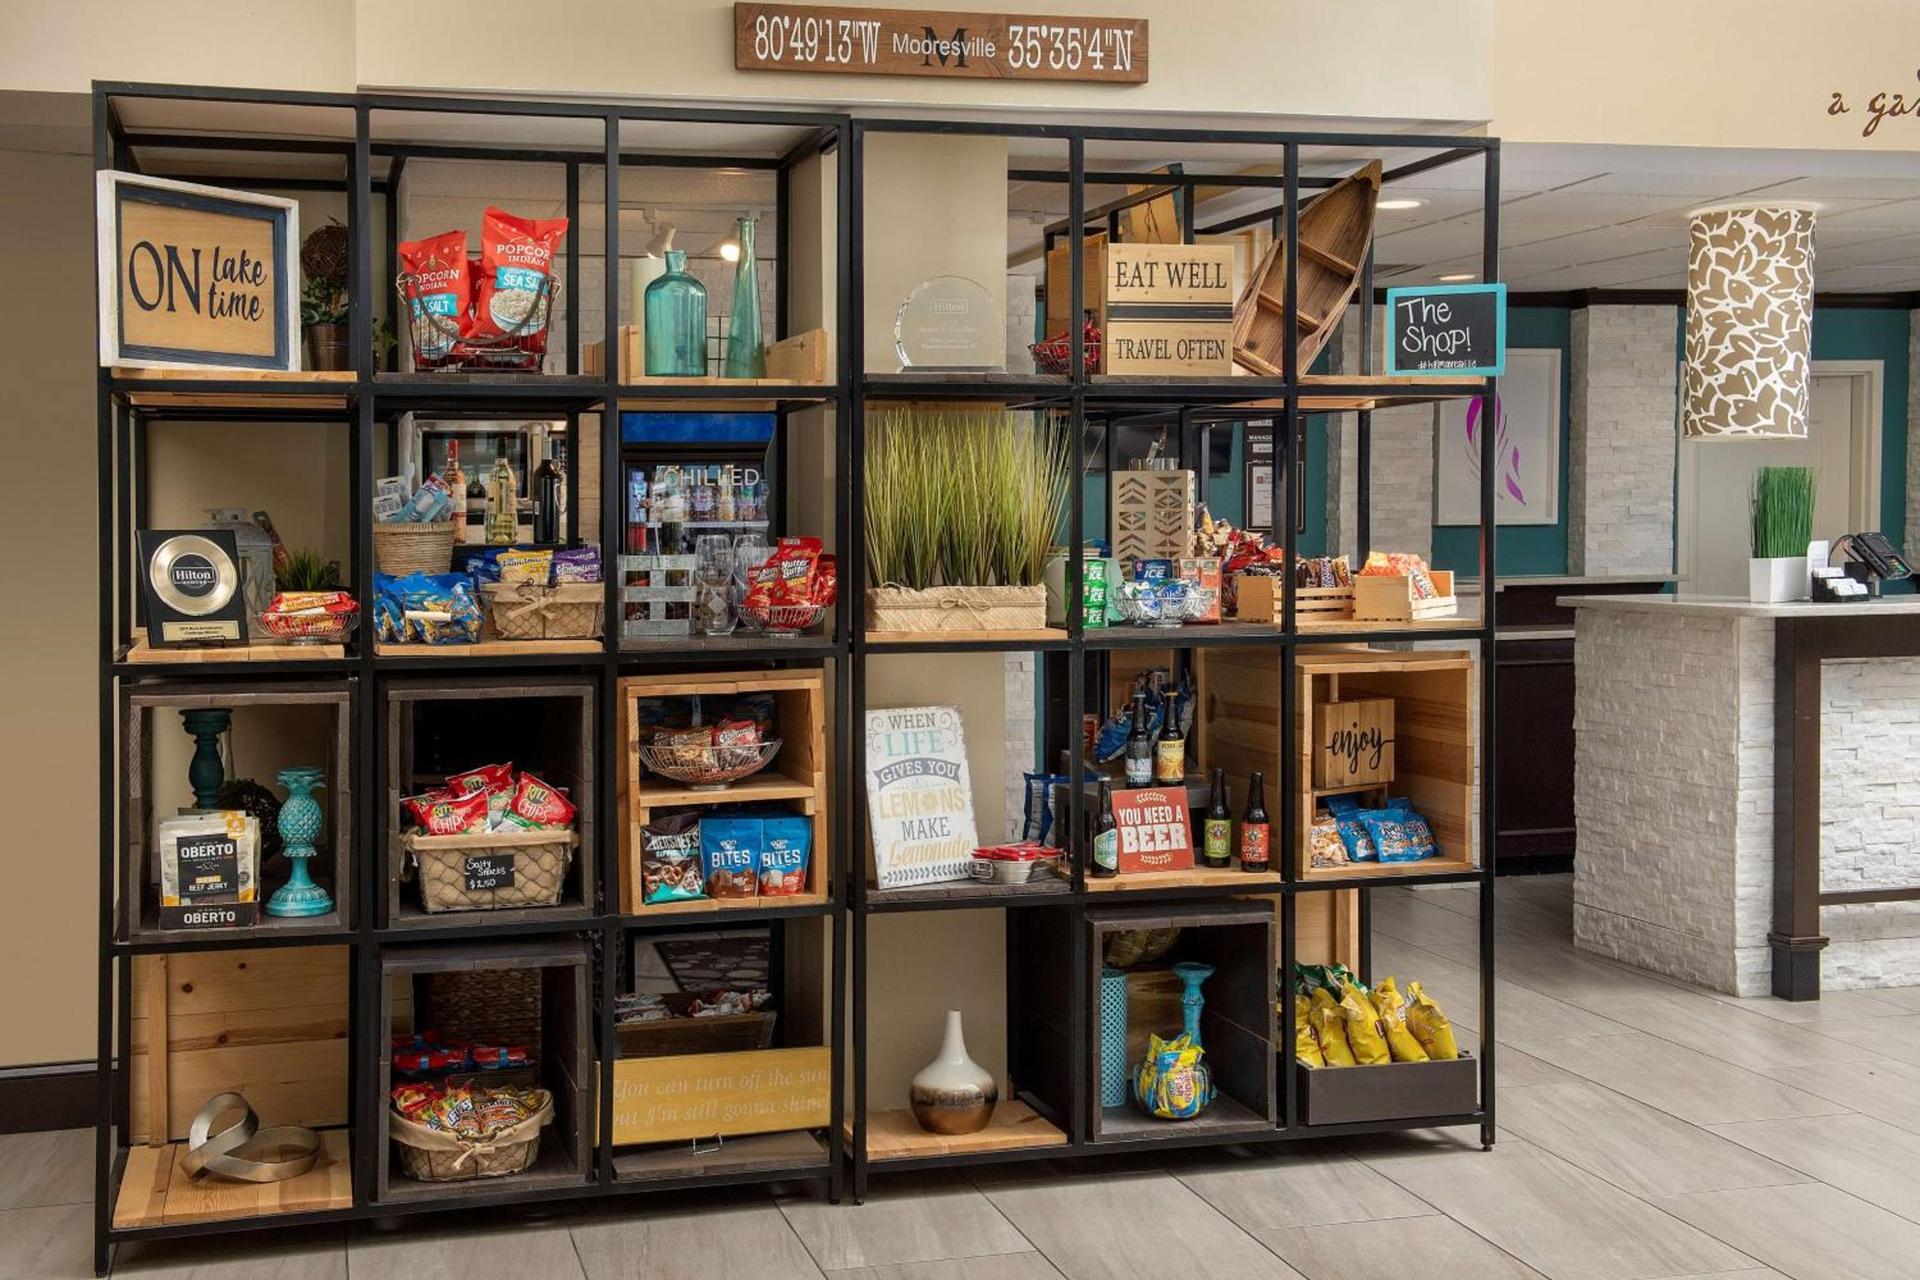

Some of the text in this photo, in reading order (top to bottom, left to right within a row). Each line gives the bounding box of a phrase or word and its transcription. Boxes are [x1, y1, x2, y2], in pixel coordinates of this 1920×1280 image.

[892, 32, 996, 58] Mooresville
[1827, 92, 1850, 116] a
[496, 243, 550, 260] POPCOR
[128, 240, 202, 315] ON
[212, 246, 267, 287] lake
[1115, 261, 1227, 289] EAT WELL
[503, 273, 523, 288] SEA
[208, 281, 264, 322] time
[1397, 297, 1452, 325] The
[1115, 338, 1226, 361] TRAVEL OFTEN
[1402, 325, 1472, 357] Shop!
[663, 468, 760, 486] CHILLED
[175, 570, 211, 580] Hilton
[1143, 569, 1165, 578] ICE
[888, 712, 937, 729] WHEN
[883, 730, 944, 757] LIFE
[1328, 722, 1390, 775] enjoy
[881, 760, 957, 783] GIVES YOU
[527, 784, 549, 801] RITZ
[517, 800, 550, 823] CHIPS
[1118, 805, 1184, 825] YOU NEED A
[433, 816, 467, 833] CHIPS
[901, 816, 951, 842] MAKE
[1120, 822, 1189, 854] BEER
[180, 843, 234, 859] OBERTO
[711, 849, 751, 868] BITES
[761, 849, 801, 867] BITES
[889, 834, 970, 868] Lemonade
[183, 911, 236, 924] OBERTO
[768, 1066, 793, 1086] the
[684, 1098, 718, 1121] still
[722, 1100, 777, 1121] gonna
